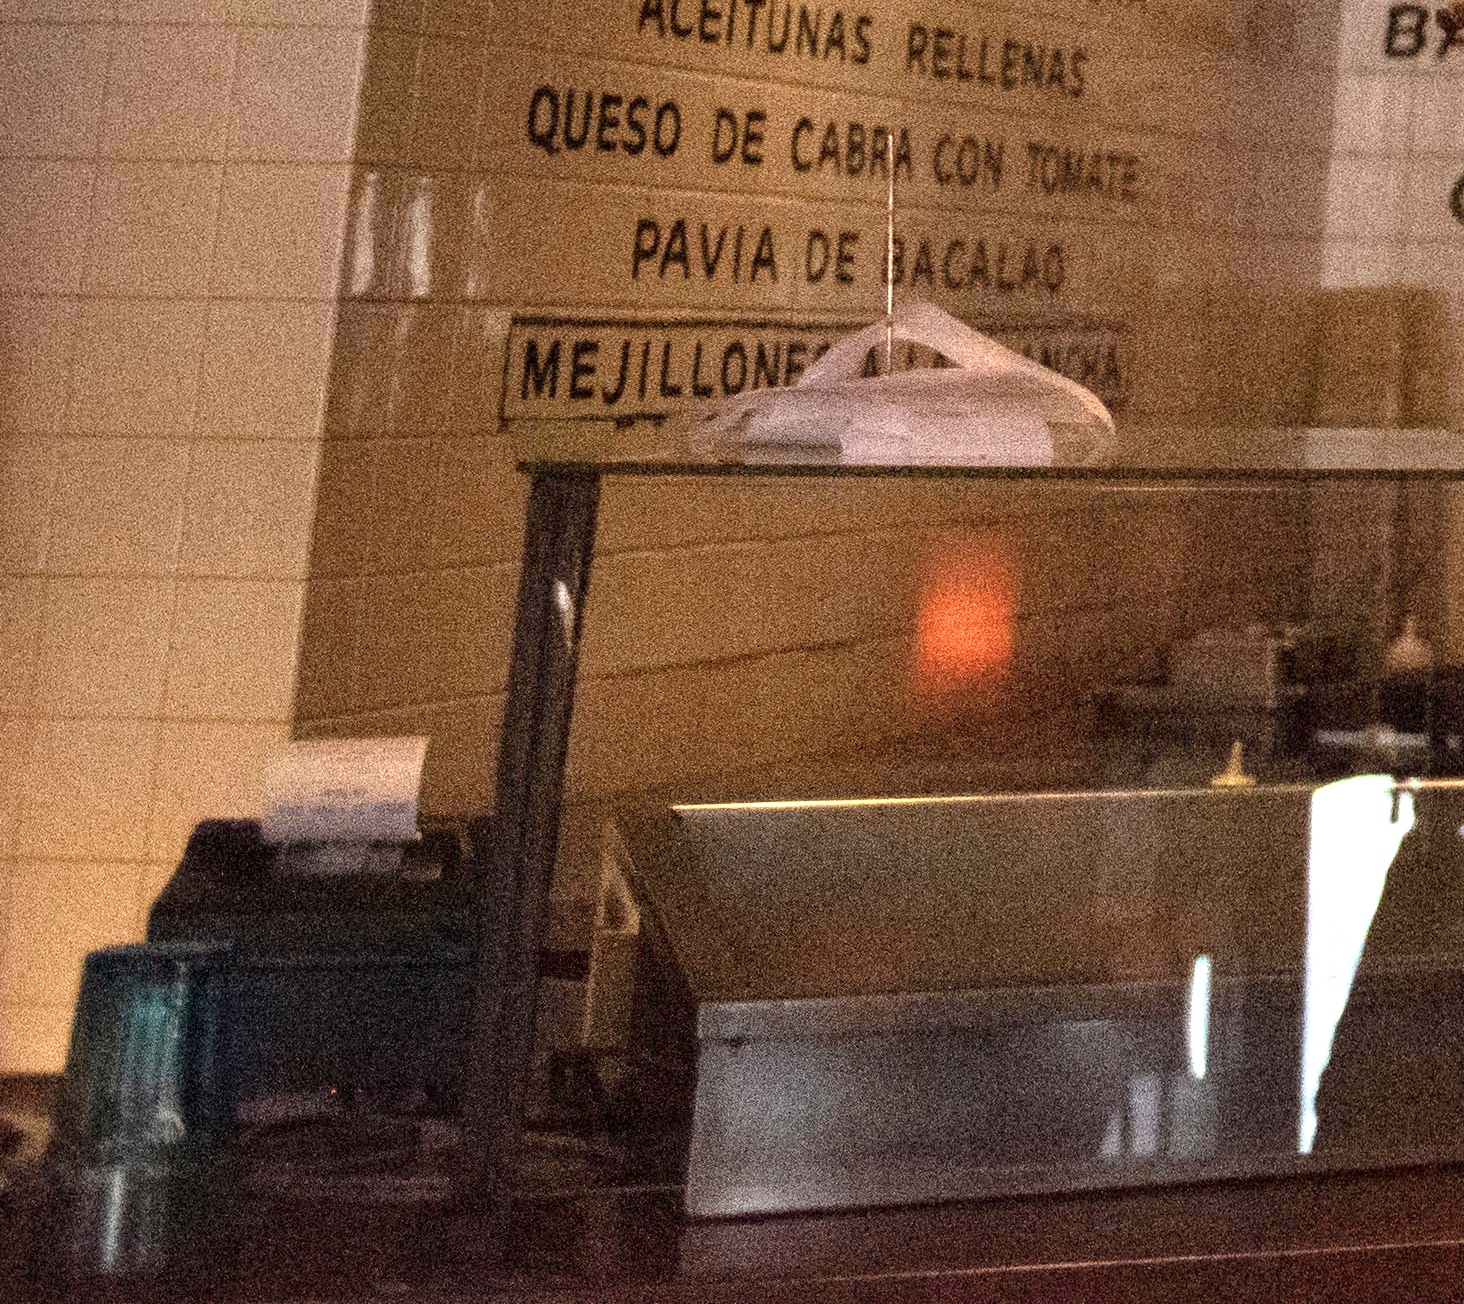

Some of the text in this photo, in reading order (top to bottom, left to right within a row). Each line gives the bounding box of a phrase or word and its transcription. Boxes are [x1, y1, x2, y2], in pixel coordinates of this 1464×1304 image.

[905, 21, 1090, 98] RELLENAS
[527, 86, 1140, 200] QUESO DE CABRA CON TOMATE
[631, 217, 1065, 295] PAVIA DE BACALAO
